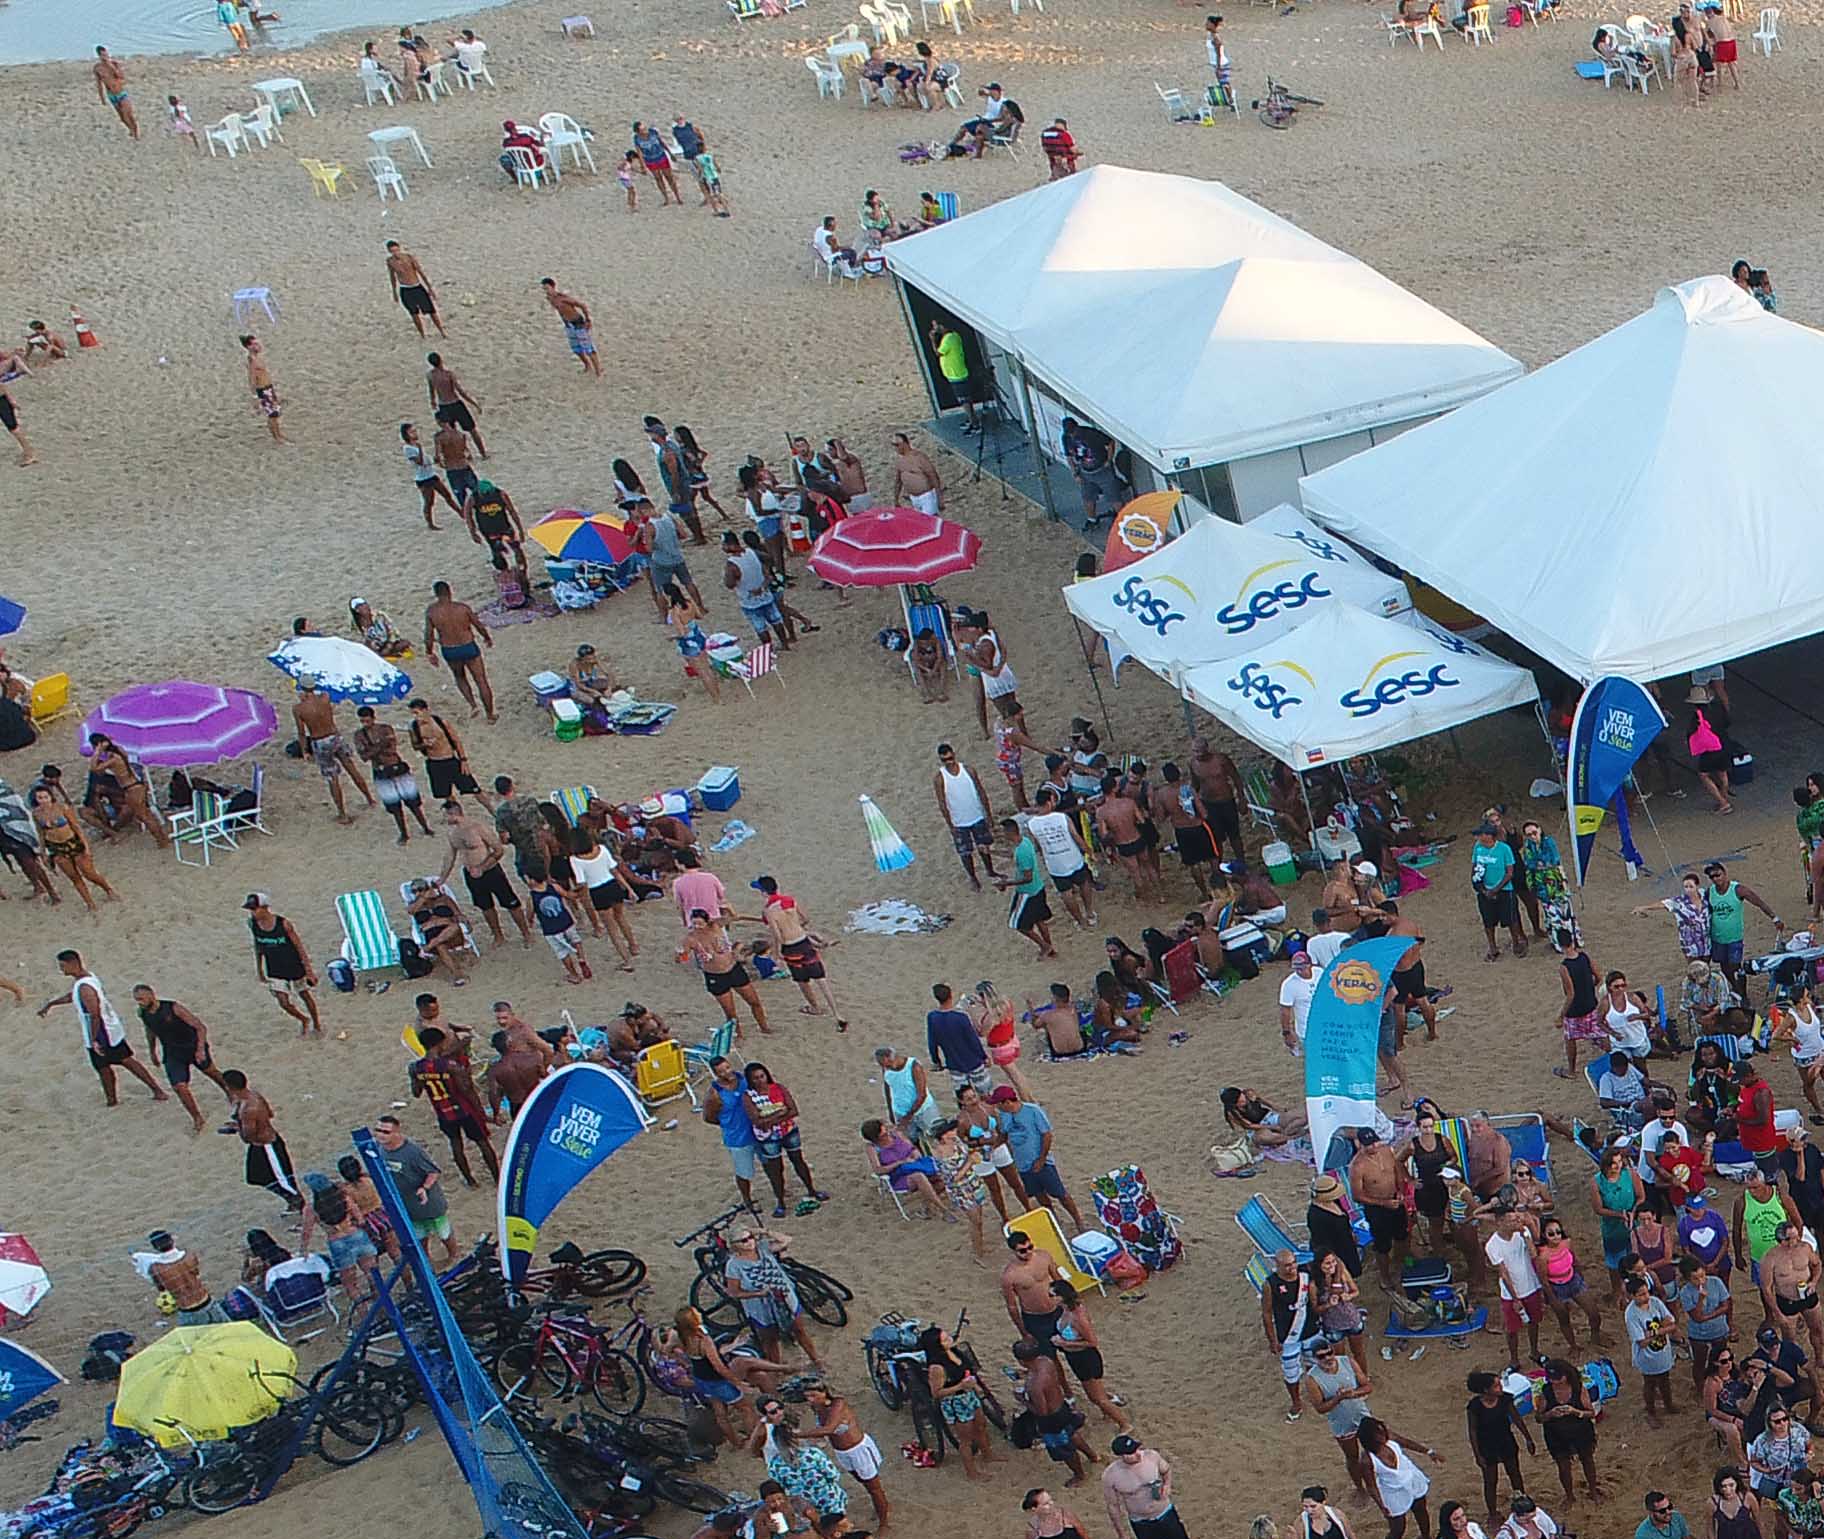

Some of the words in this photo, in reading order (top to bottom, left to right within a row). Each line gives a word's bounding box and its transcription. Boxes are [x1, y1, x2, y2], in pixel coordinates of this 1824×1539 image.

[1113, 575, 1185, 637] Sesc
[1217, 571, 1331, 633] Sesc
[1227, 662, 1302, 719] Sesc
[1340, 664, 1460, 719] Sesc
[1603, 720, 1635, 739] VIVER
[1609, 708, 1634, 727] VEM
[1336, 976, 1377, 992] VERÃO
[570, 1103, 602, 1125] VEM
[560, 1118, 600, 1144] VIVER
